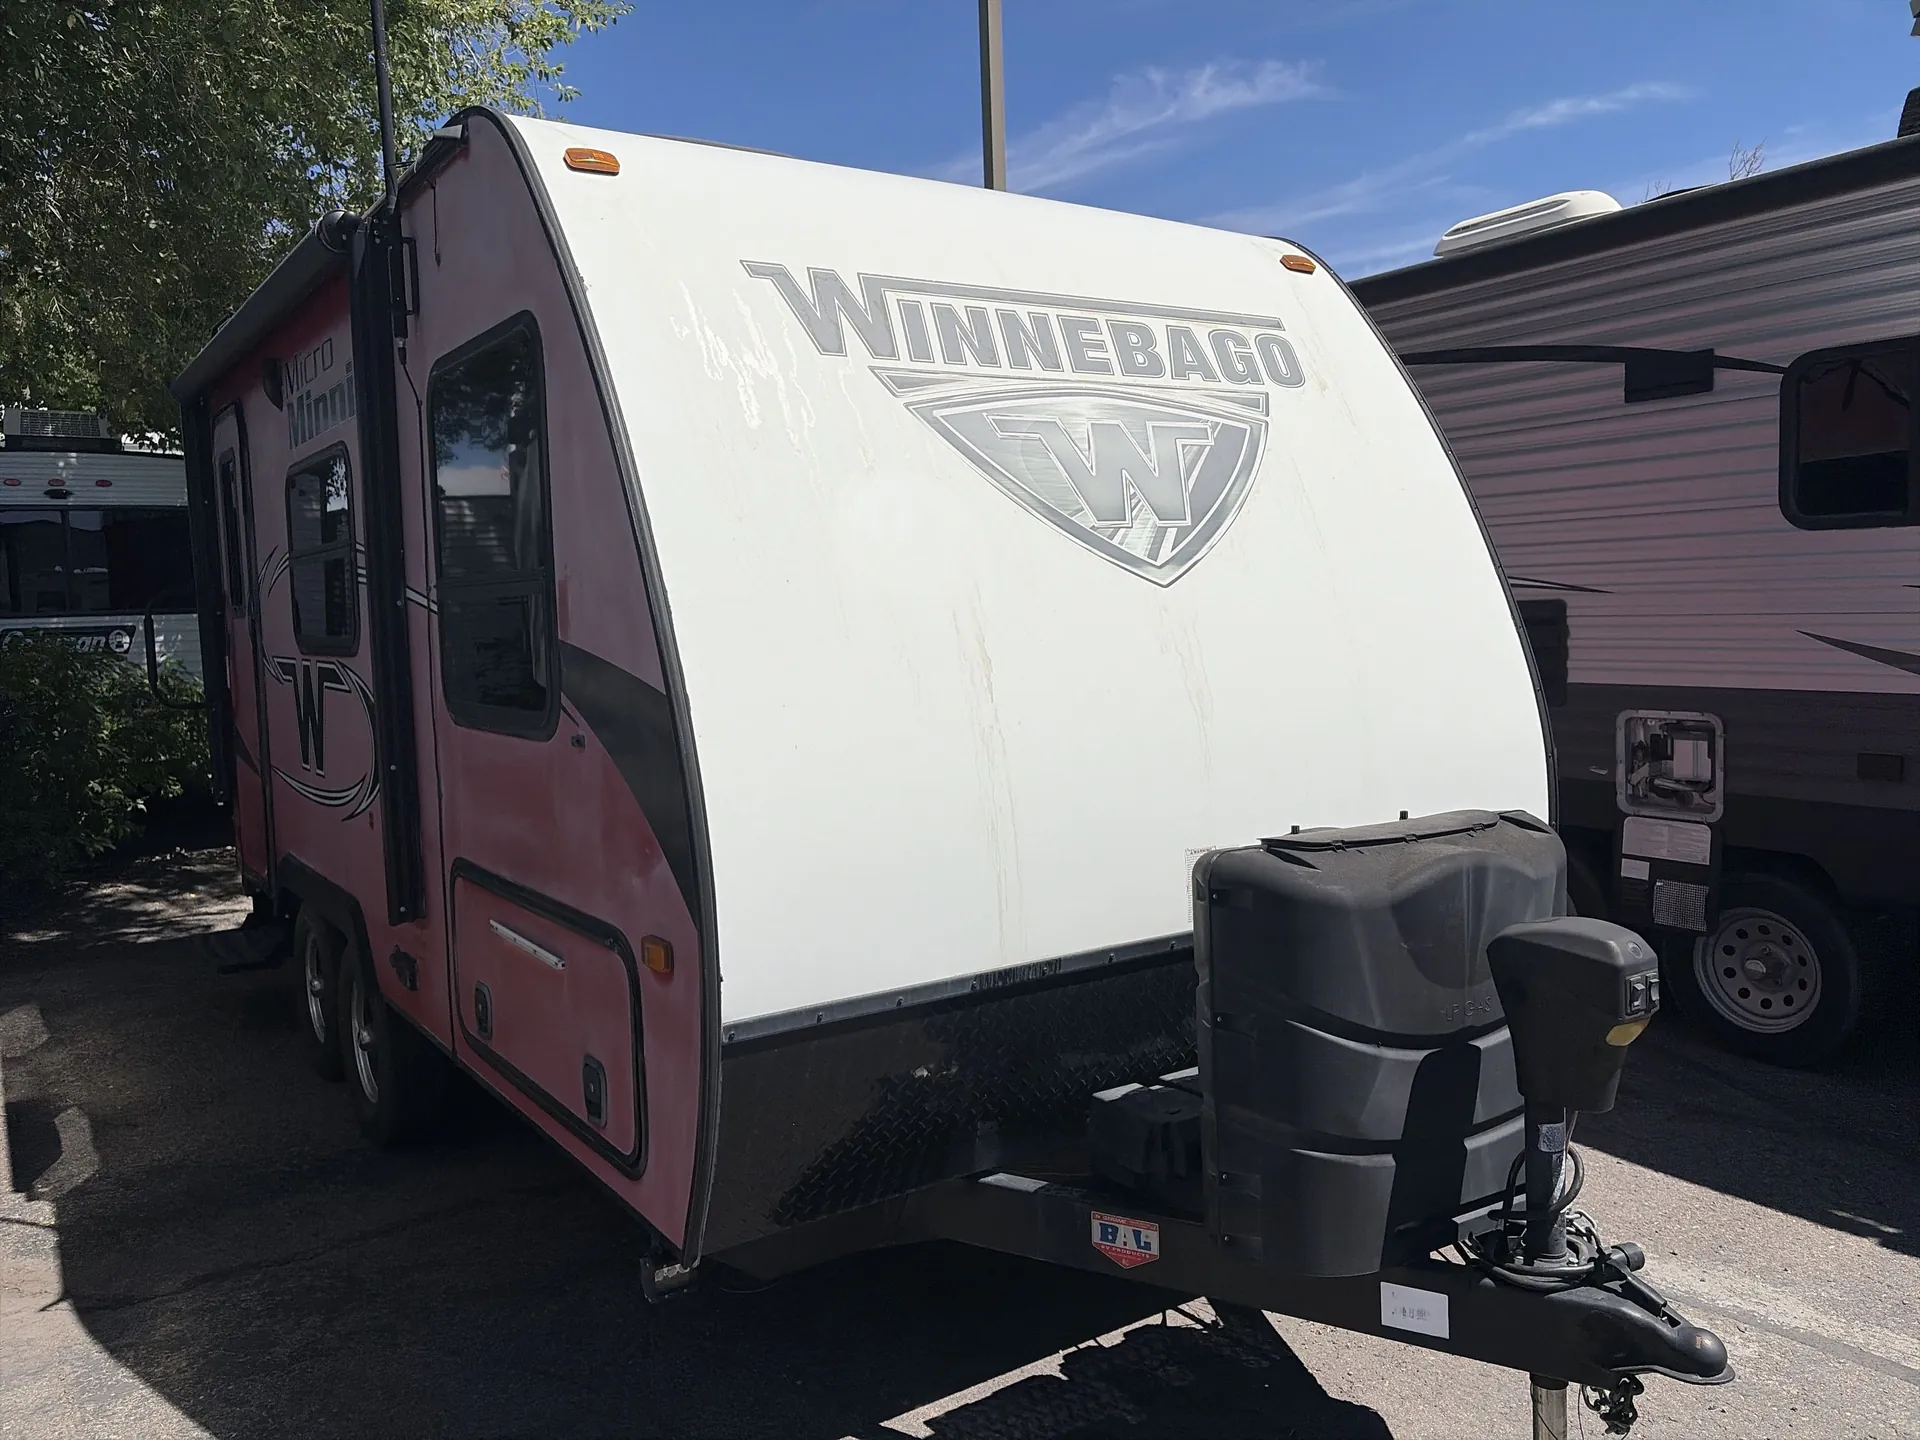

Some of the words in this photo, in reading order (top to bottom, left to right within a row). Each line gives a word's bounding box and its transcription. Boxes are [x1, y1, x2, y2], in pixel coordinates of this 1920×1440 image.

[739, 258, 1306, 389] WINNEBAGO
[282, 336, 334, 399] Micro
[286, 360, 358, 451] Minni
[984, 412, 1216, 528] W
[272, 656, 352, 778] W
[1464, 996, 1493, 1017] GAS
[1099, 1222, 1152, 1251] BAL
[1112, 1247, 1150, 1259] PRODUCTS
